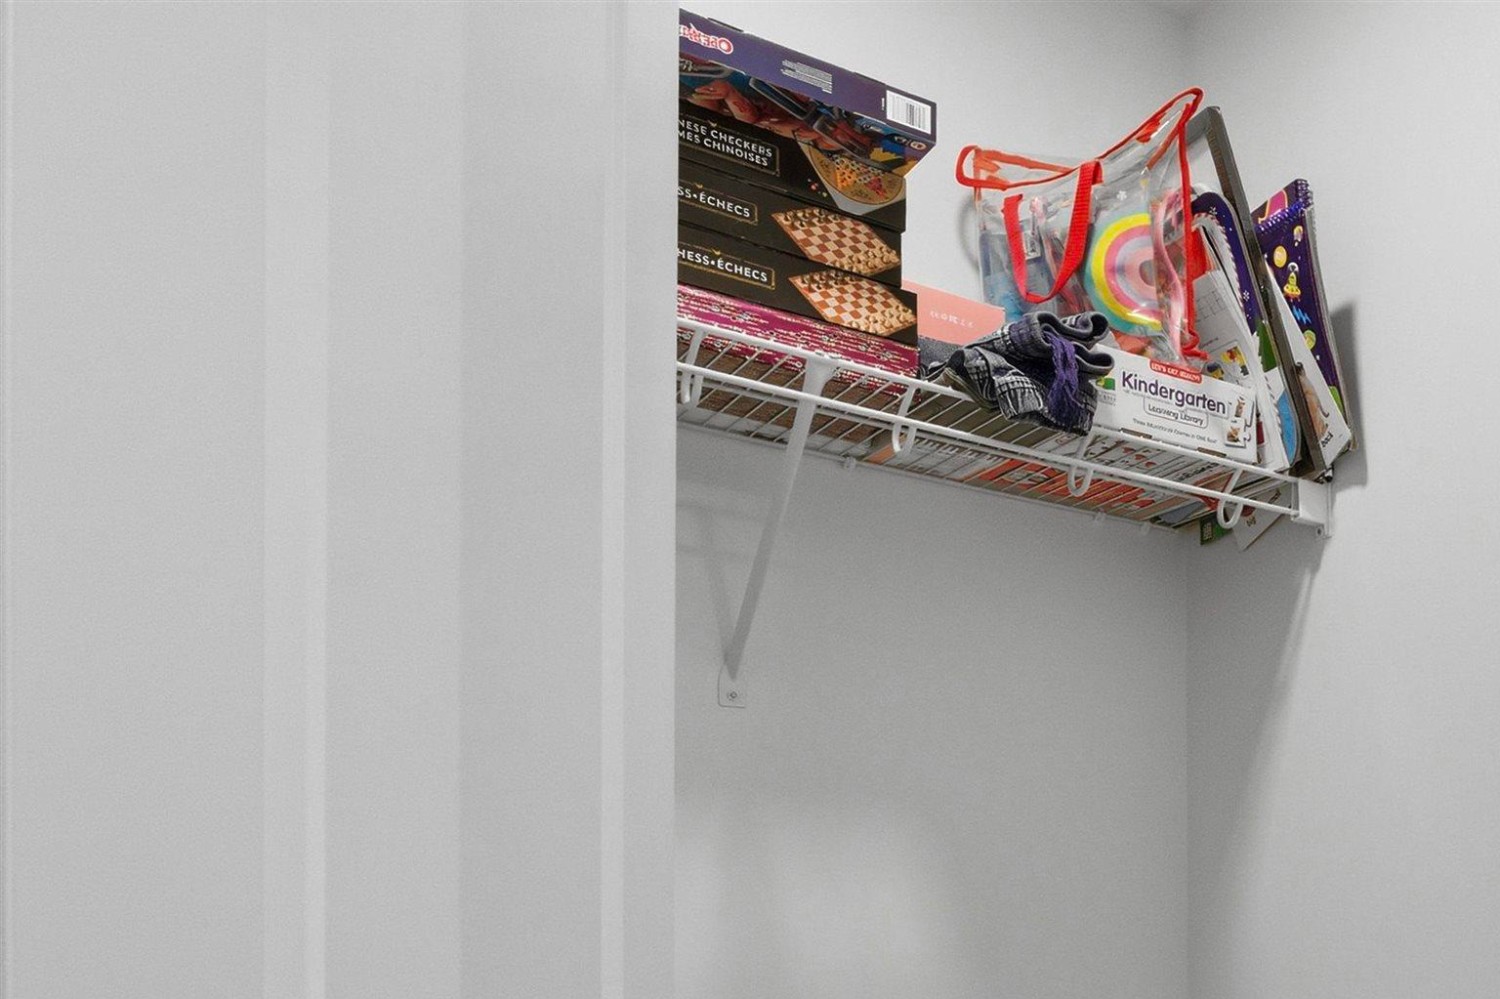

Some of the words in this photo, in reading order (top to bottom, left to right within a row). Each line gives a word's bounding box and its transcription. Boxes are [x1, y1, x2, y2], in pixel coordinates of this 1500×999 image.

[678, 119, 708, 135] NESE
[710, 129, 773, 158] CHECKERS
[678, 129, 701, 144] MES
[703, 138, 768, 167] CHINOISES
[1121, 370, 1227, 415] Kindergarten
[1148, 403, 1179, 420] Learning
[1179, 410, 1204, 426] Library
